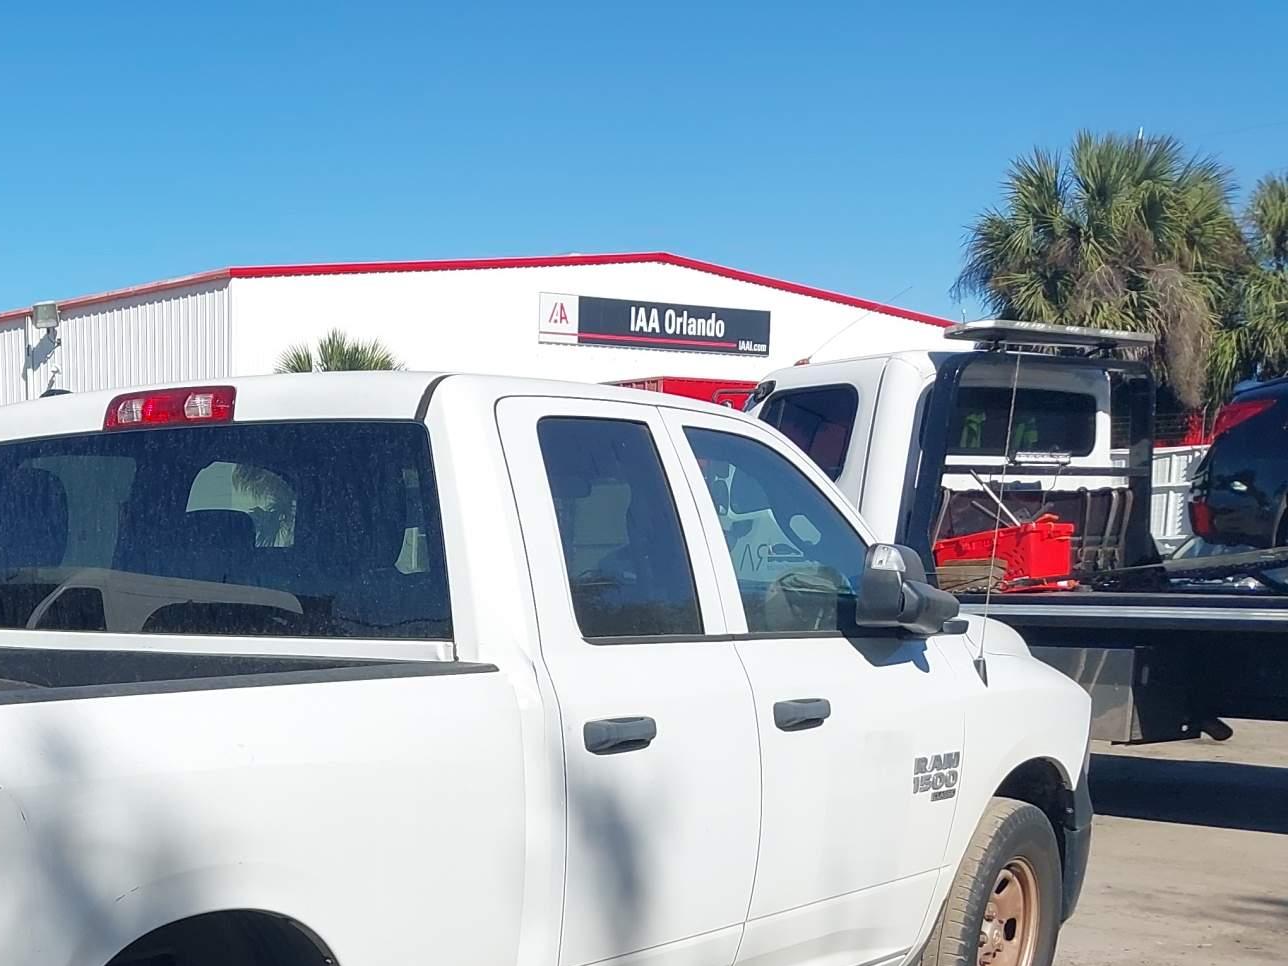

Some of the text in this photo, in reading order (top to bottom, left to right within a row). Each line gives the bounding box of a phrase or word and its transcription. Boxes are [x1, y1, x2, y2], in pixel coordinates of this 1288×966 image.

[630, 306, 725, 337] IAA Orlando
[913, 751, 960, 775] RAM
[912, 770, 958, 794] 1500
